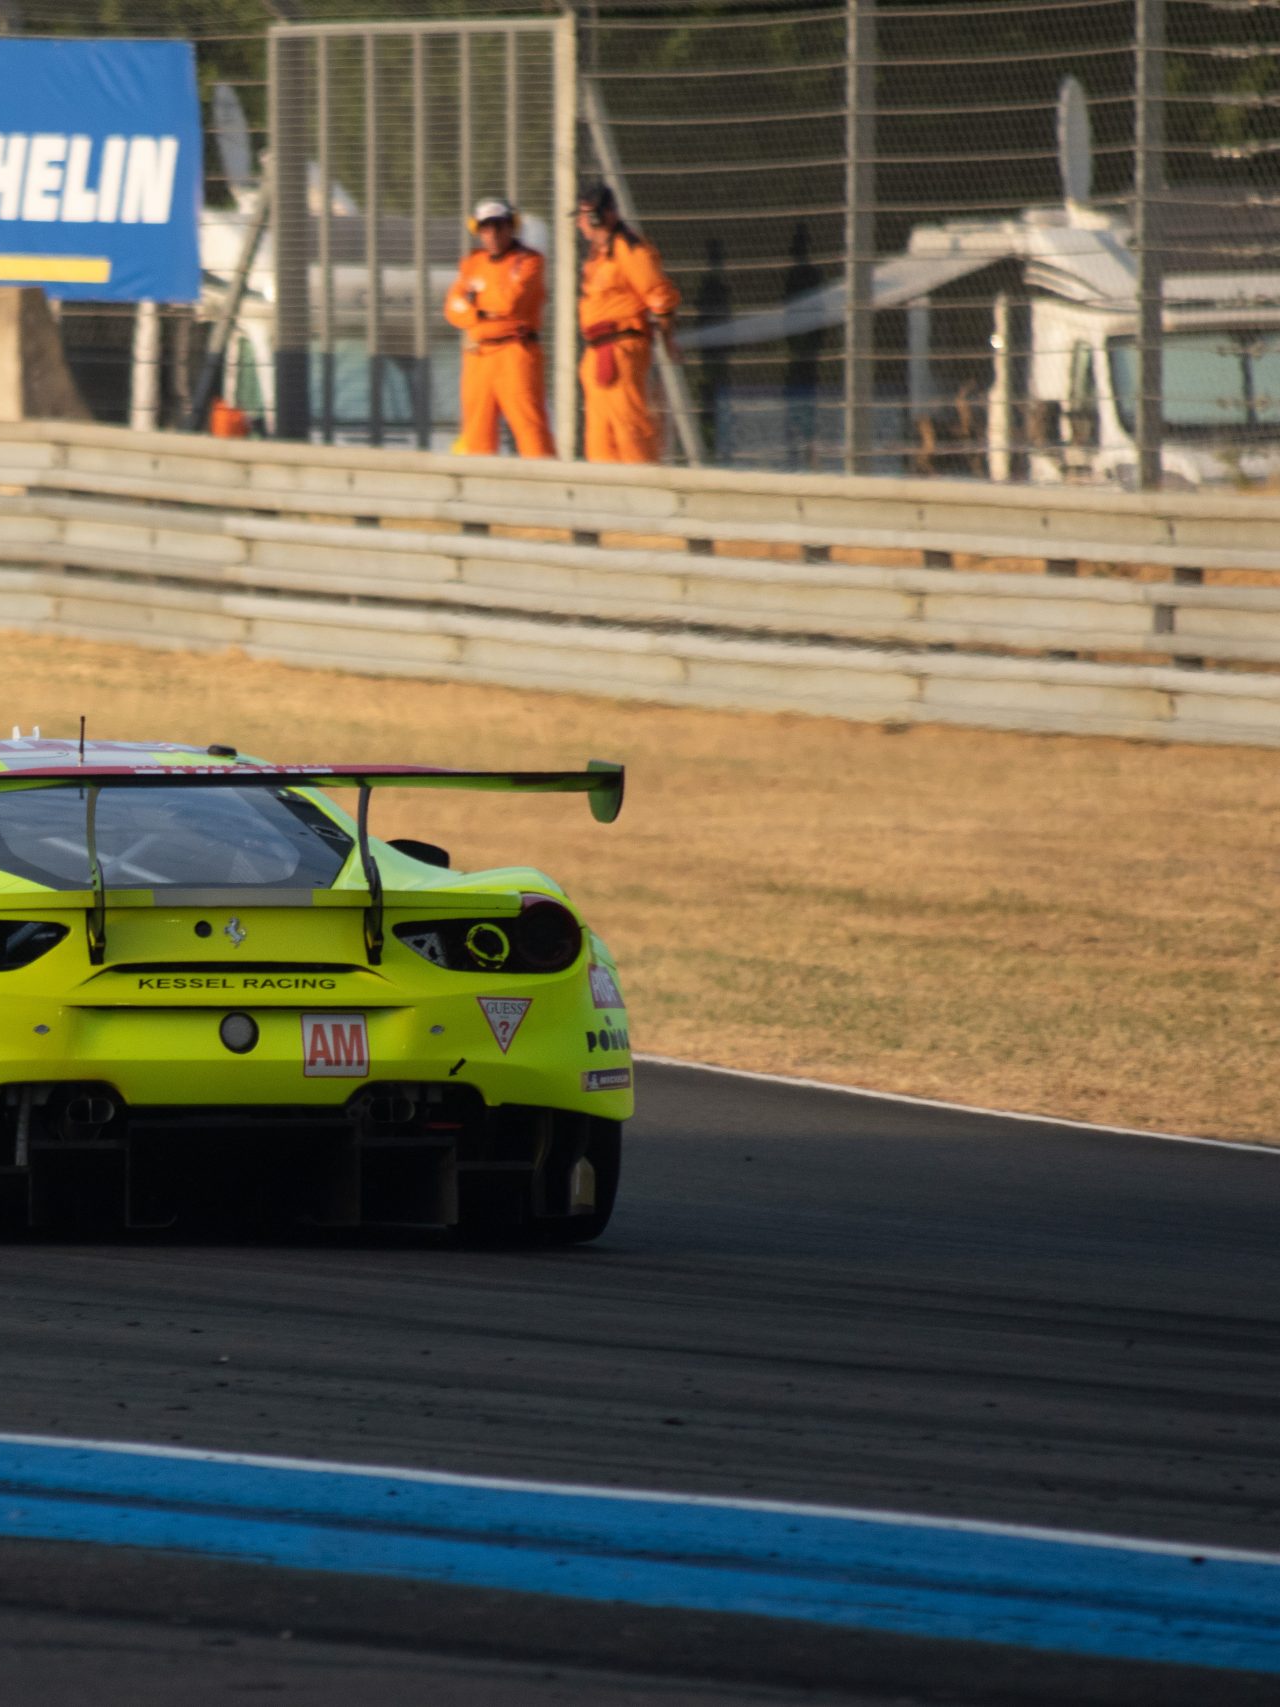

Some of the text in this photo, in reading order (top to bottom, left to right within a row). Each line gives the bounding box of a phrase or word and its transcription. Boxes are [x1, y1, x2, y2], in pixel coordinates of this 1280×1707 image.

[138, 978, 337, 990] KESSEL RACING
[486, 1002, 524, 1015] GUESS
[308, 1023, 365, 1067] AM
